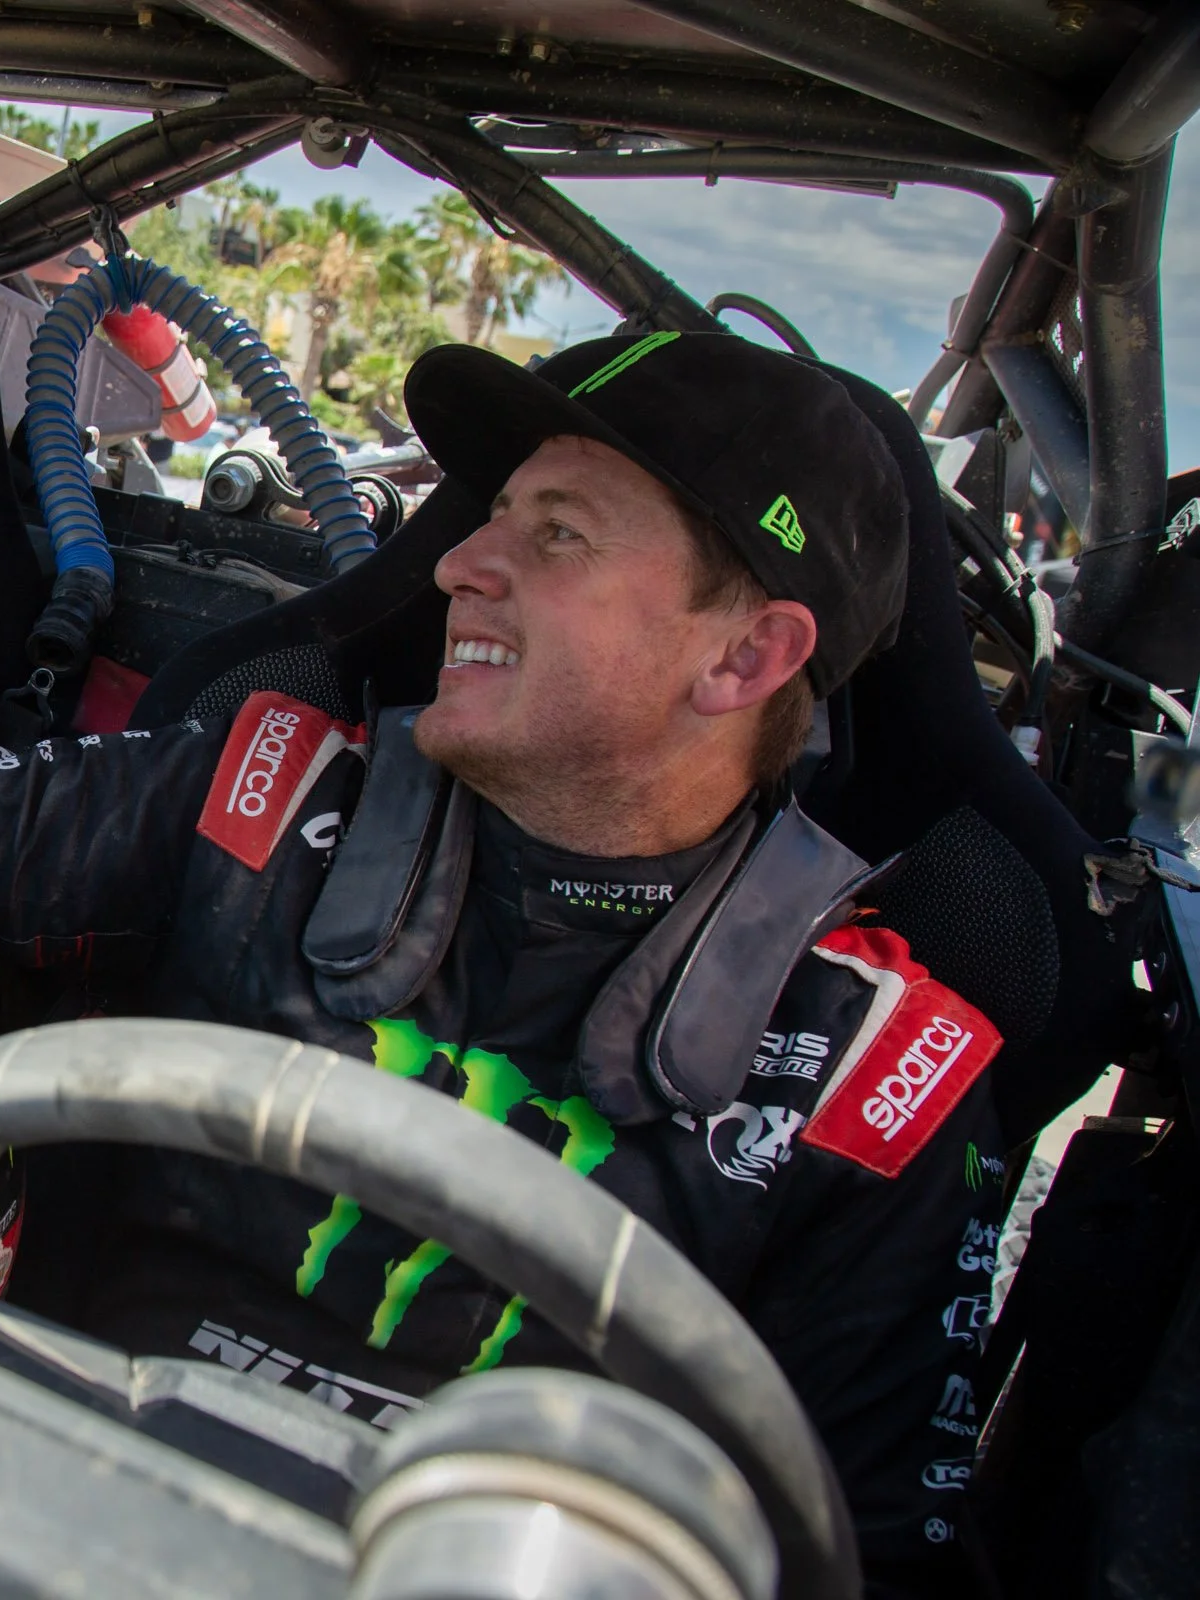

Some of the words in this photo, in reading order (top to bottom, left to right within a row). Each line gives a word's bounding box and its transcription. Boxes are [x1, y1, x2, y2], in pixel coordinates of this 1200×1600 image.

[226, 708, 301, 817] sparco
[550, 879, 674, 902] MONSTER
[570, 898, 655, 915] ENERGY
[760, 1031, 830, 1058] RIS
[752, 1058, 822, 1076] ACING
[862, 1016, 974, 1142] sparco
[672, 1101, 808, 1191] OX
[962, 1217, 1000, 1249] Moti
